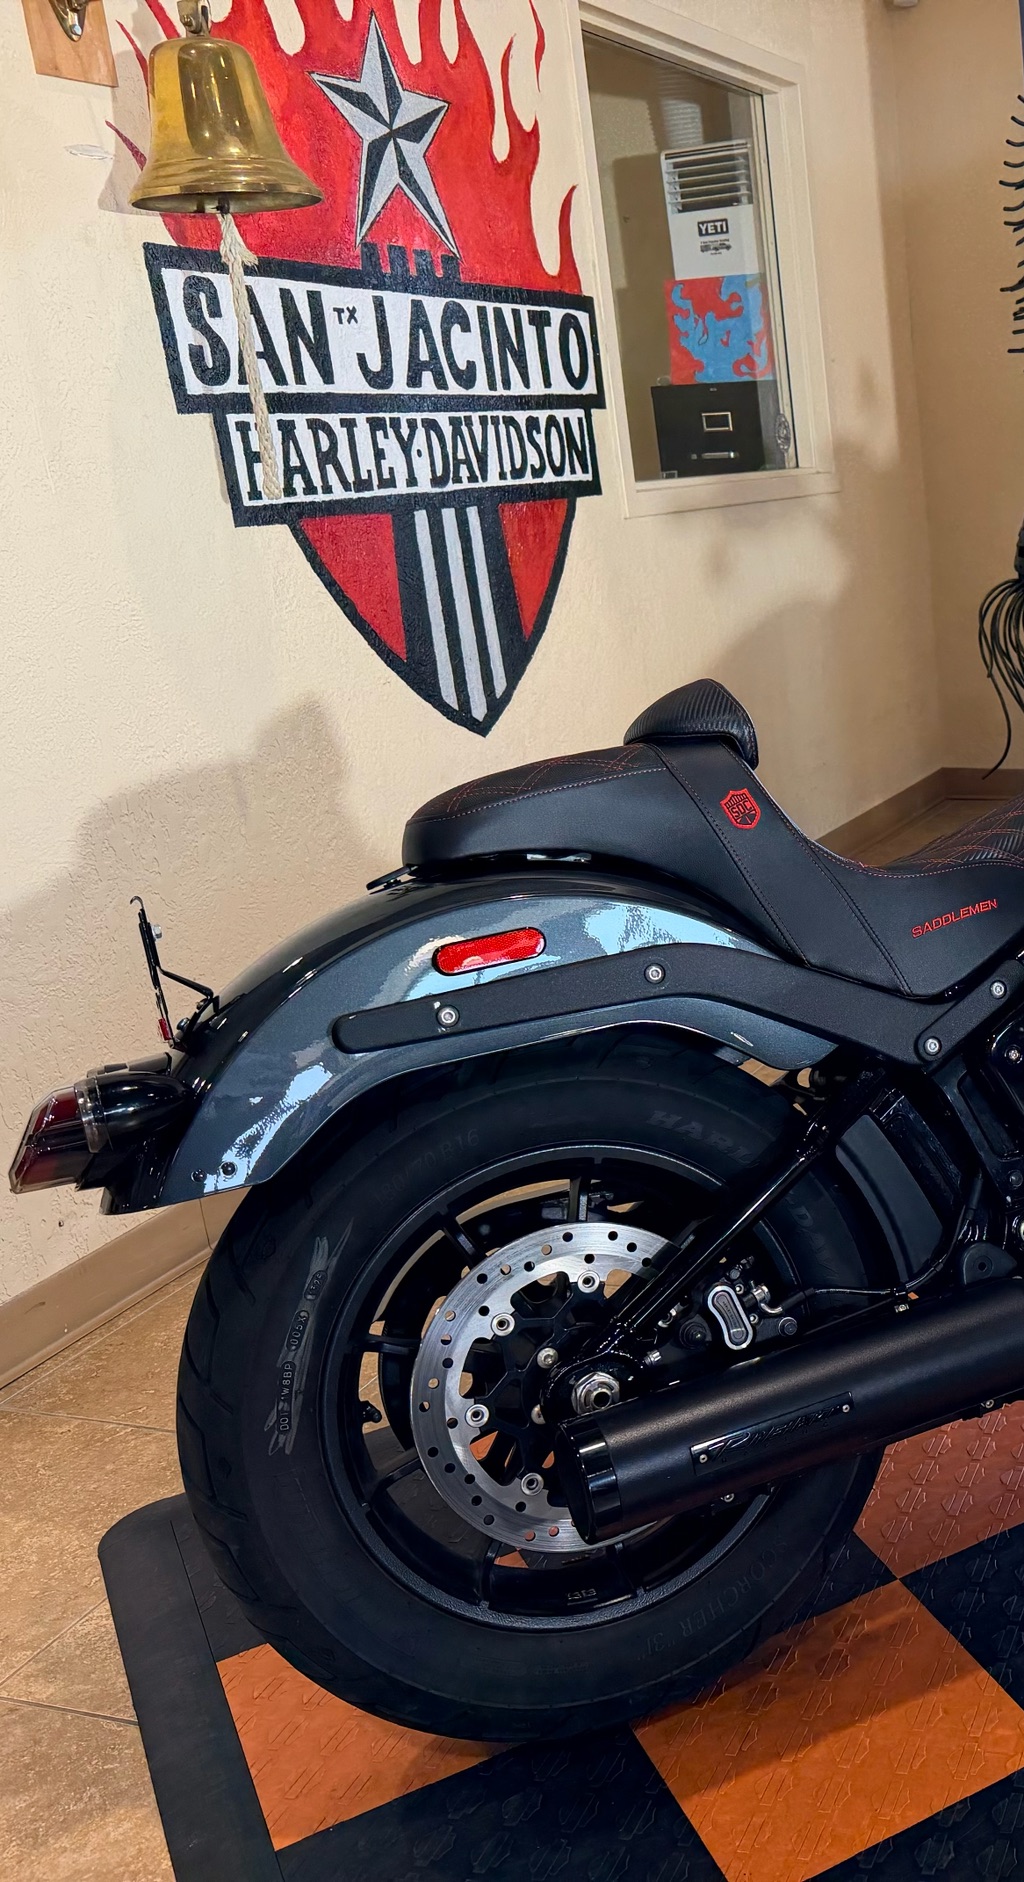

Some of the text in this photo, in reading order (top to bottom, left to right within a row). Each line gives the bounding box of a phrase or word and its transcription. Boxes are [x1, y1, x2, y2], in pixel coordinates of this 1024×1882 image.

[698, 220, 727, 235] YETI
[182, 275, 589, 391] SAN TX JACINTO
[911, 899, 998, 939] SADDLEMEN
